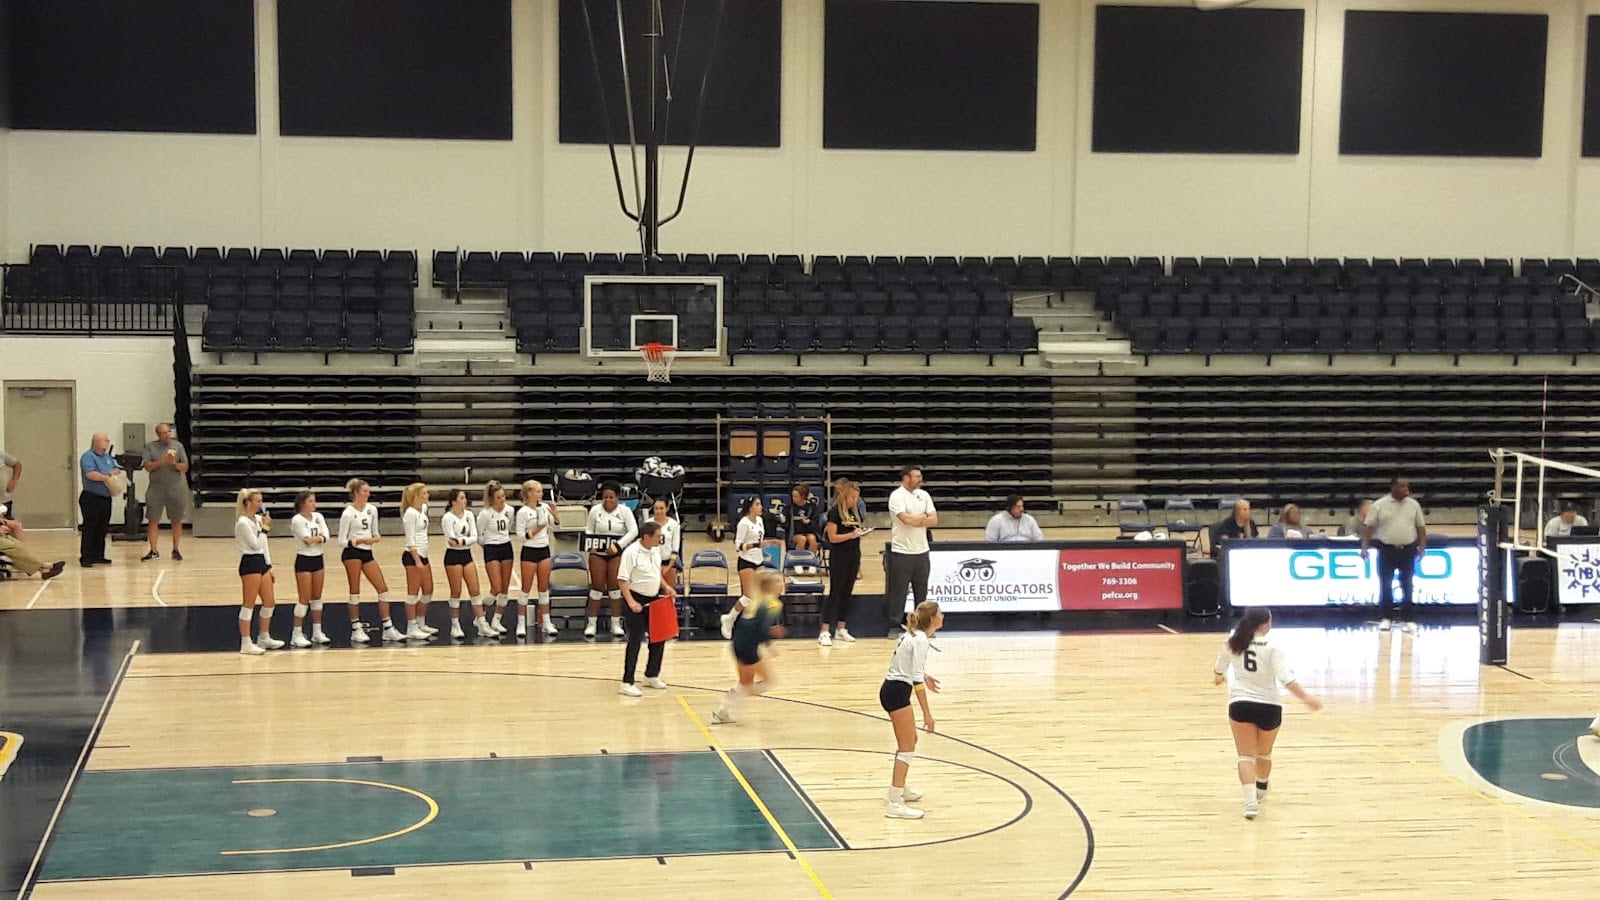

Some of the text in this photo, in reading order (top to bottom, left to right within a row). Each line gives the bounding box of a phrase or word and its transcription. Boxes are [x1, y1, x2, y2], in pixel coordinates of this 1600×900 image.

[496, 520, 506, 531] 10
[1061, 561, 1176, 573] Together We Build Community
[1289, 549, 1453, 580] GEIO
[1101, 577, 1138, 586] 769-3306
[979, 583, 1053, 595] EDUCATORS
[993, 595, 1018, 603] UNION
[1101, 590, 1139, 601] pefcu.org
[1244, 651, 1257, 672] 6
